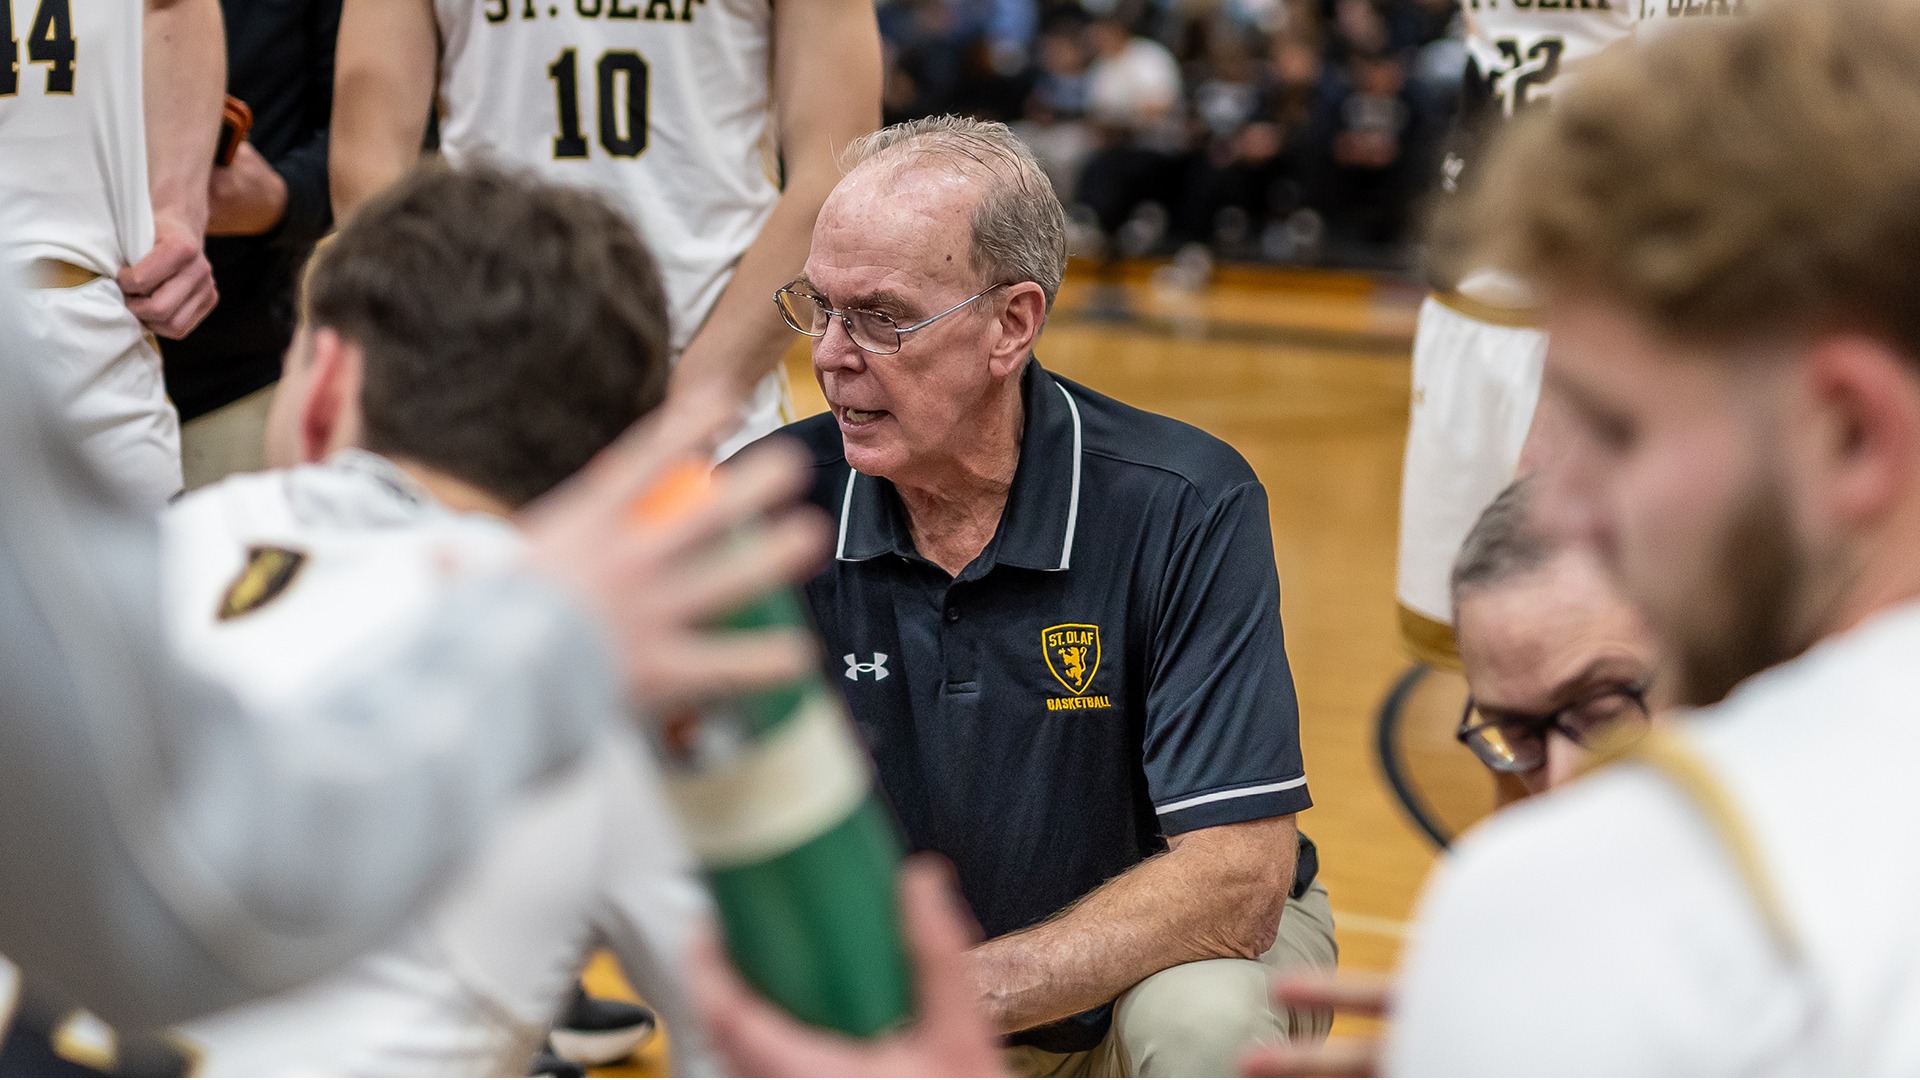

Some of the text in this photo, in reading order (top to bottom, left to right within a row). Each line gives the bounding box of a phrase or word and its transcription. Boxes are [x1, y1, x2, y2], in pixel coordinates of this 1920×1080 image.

[547, 47, 652, 160] 10
[1048, 631, 1094, 647] ST. OLAF
[1046, 696, 1111, 710] BASKETBALL
